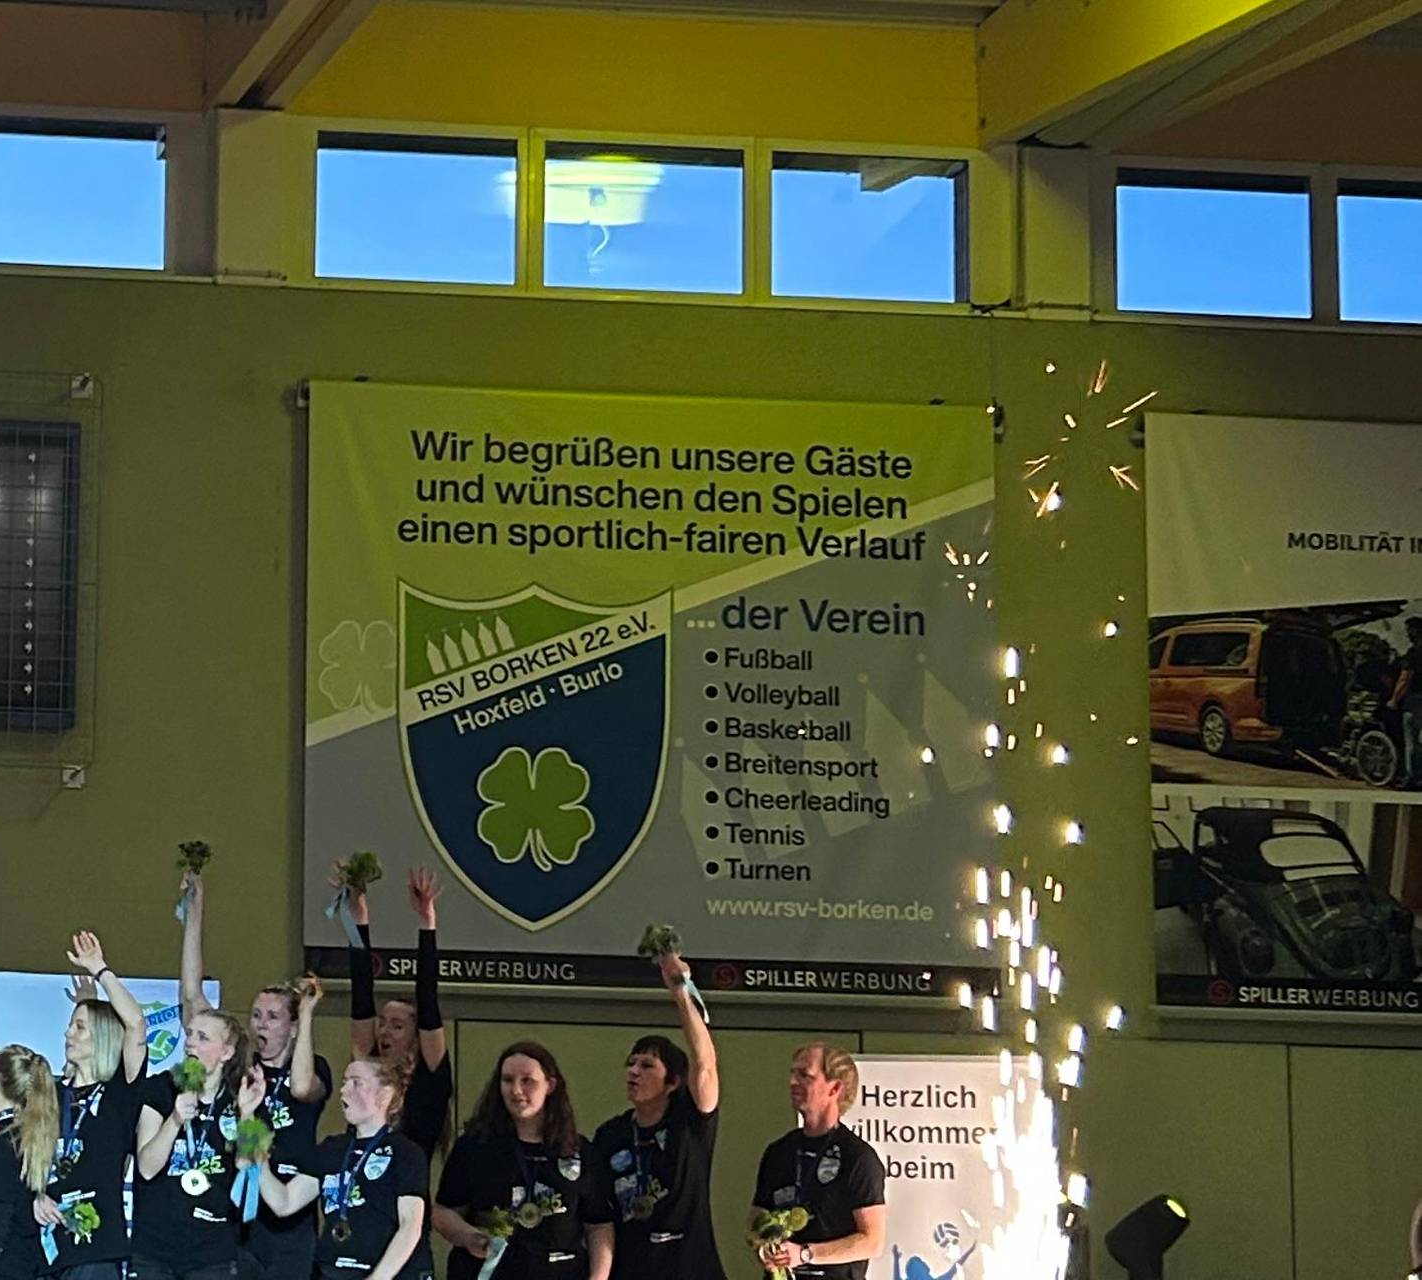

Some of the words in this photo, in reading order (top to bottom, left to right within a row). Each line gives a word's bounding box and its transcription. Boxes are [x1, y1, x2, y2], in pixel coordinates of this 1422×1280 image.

[411, 430, 473, 461] Wir
[484, 433, 660, 473] begrüßen
[672, 448, 795, 474] unsere
[805, 444, 912, 479] Gäste
[416, 473, 484, 503] und
[495, 476, 683, 511] wünschen
[694, 482, 762, 513] den
[772, 484, 907, 523] Spielen
[397, 513, 497, 545] einen
[508, 518, 786, 556] sportlich-fairen
[796, 526, 926, 561] Verlauf
[1287, 531, 1405, 554] MOBILITÄT
[799, 598, 925, 637] Verein
[417, 676, 465, 711] RSV
[471, 638, 578, 692] BORKEN
[580, 626, 613, 653] 22
[617, 611, 656, 640] e.V.
[724, 647, 813, 671] Fußball
[452, 685, 547, 735] Hoxfeld
[558, 660, 623, 697] Burlo
[724, 682, 840, 710] Volleyball
[724, 717, 851, 742] Basketball
[724, 751, 879, 781] Breitensport
[724, 786, 891, 819] Cheerleading
[724, 822, 806, 846] Tennis
[724, 857, 812, 881] Turnen
[705, 898, 934, 921] www.rsv-borken.de
[389, 957, 576, 981] SPIERWERBUNG
[861, 1084, 977, 1109] Herzlich
[852, 1118, 998, 1144] illkomme
[886, 1154, 956, 1180] beim
